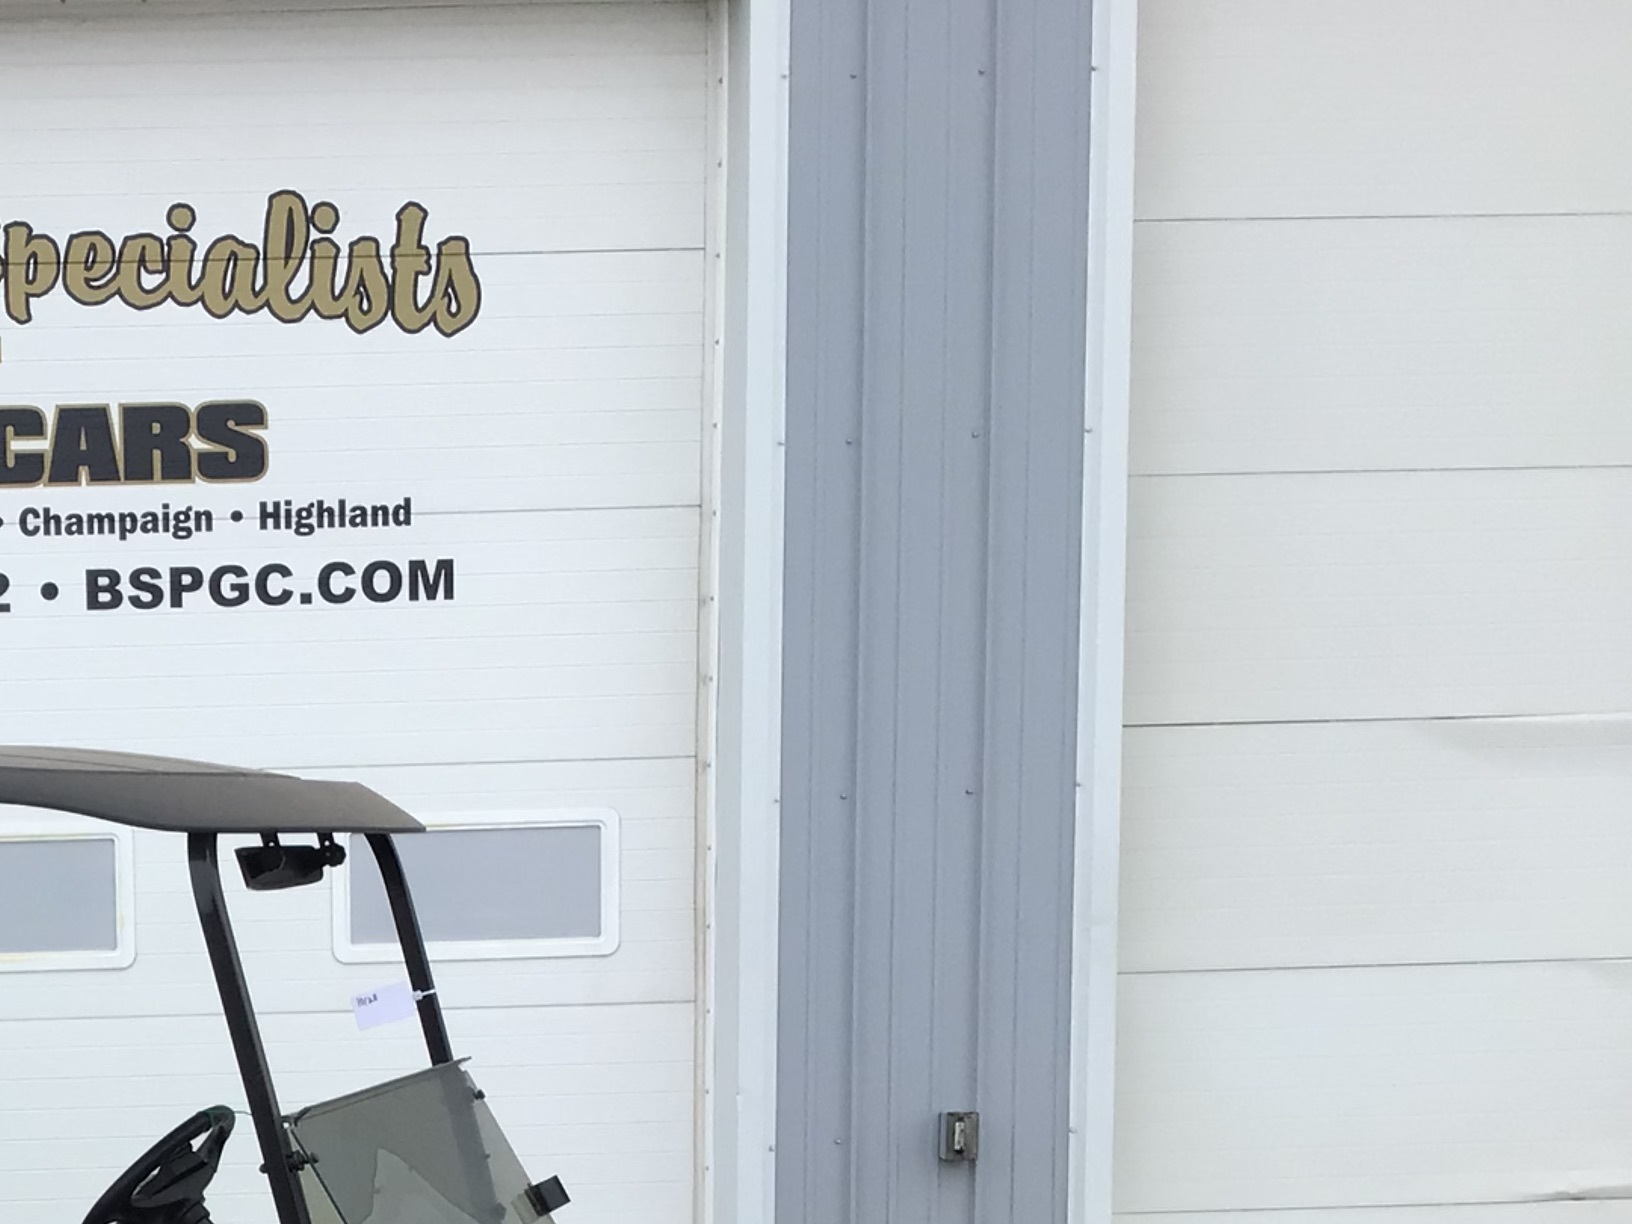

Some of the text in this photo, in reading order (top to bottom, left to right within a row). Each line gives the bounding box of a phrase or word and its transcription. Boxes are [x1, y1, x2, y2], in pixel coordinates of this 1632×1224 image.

[18, 504, 214, 540] Champaign
[258, 498, 412, 536] Highland
[84, 558, 455, 612] BSPGC.COM
